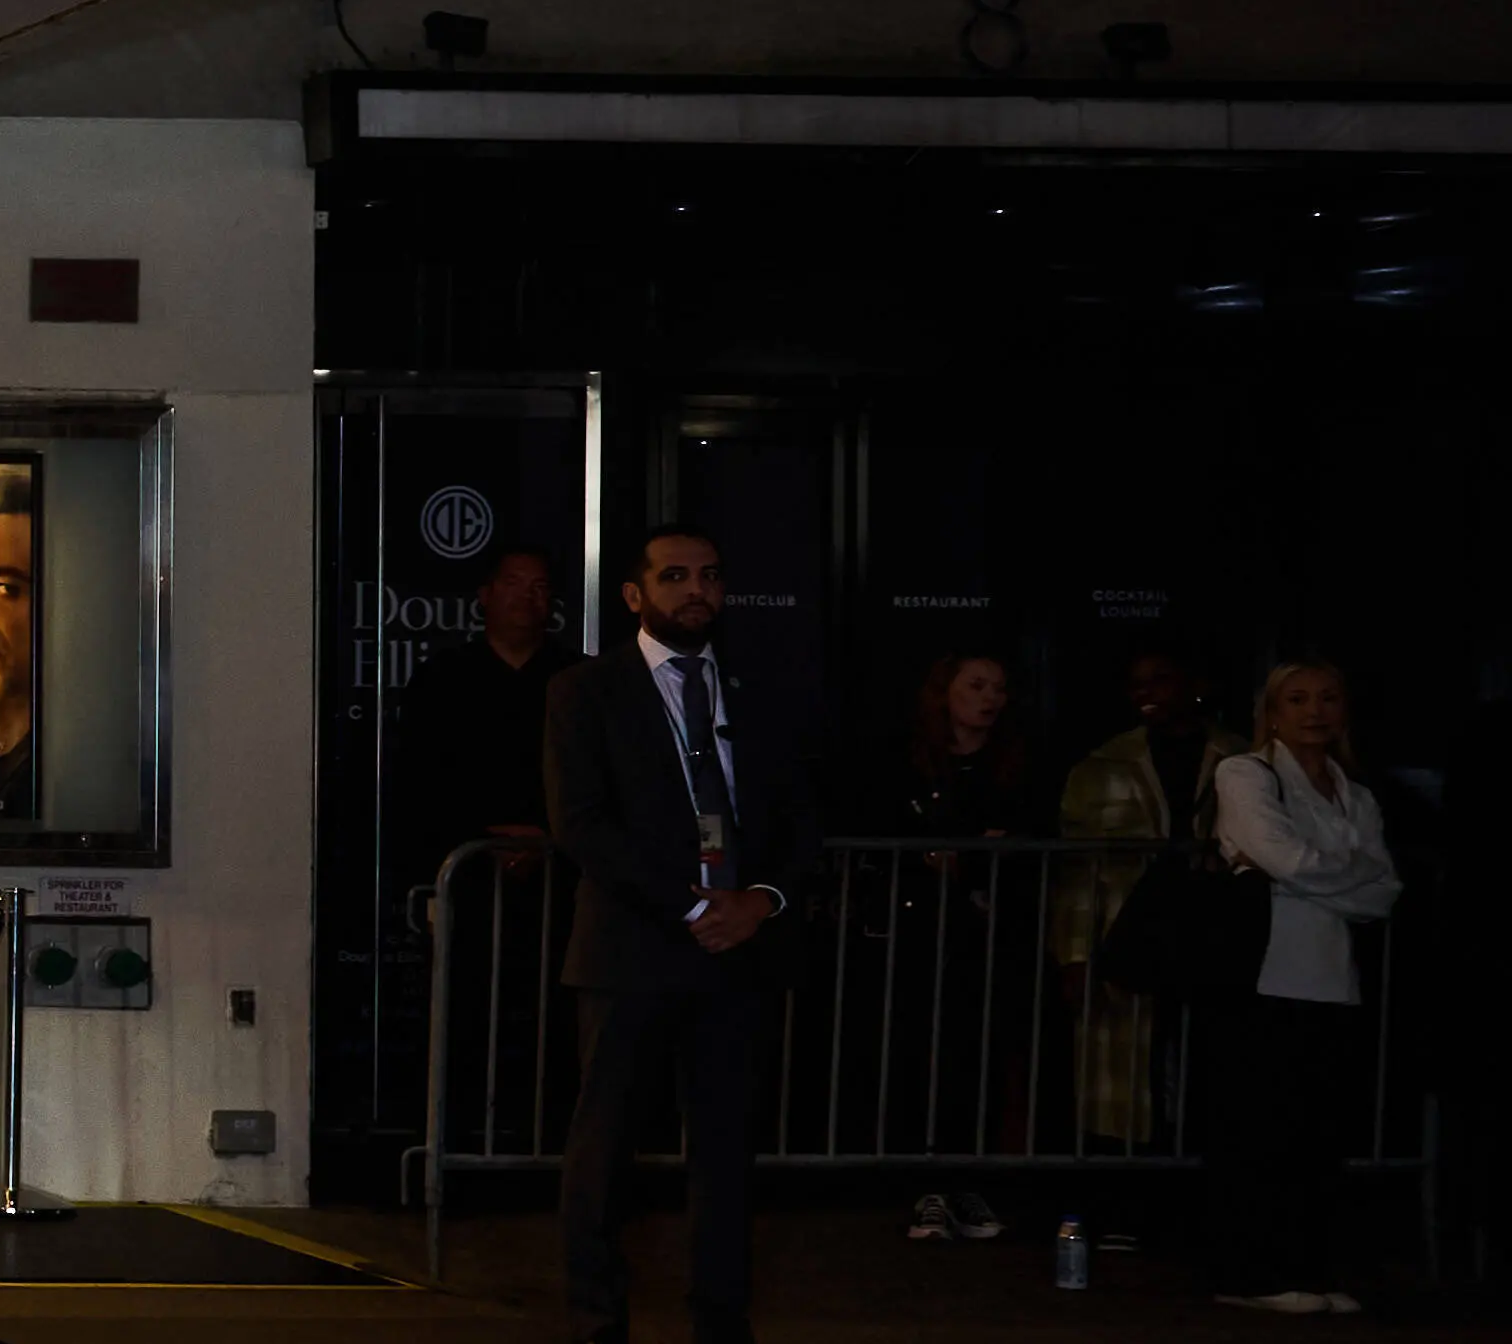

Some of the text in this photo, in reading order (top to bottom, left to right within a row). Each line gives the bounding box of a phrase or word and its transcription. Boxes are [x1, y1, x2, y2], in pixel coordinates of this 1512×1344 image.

[1091, 587, 1170, 603] COCKTAIL
[892, 594, 993, 609] RESTAURANT
[47, 879, 125, 891] SPRINKLER FOR
[59, 891, 103, 902] THEATER
[54, 902, 119, 913] RESTAURANT
